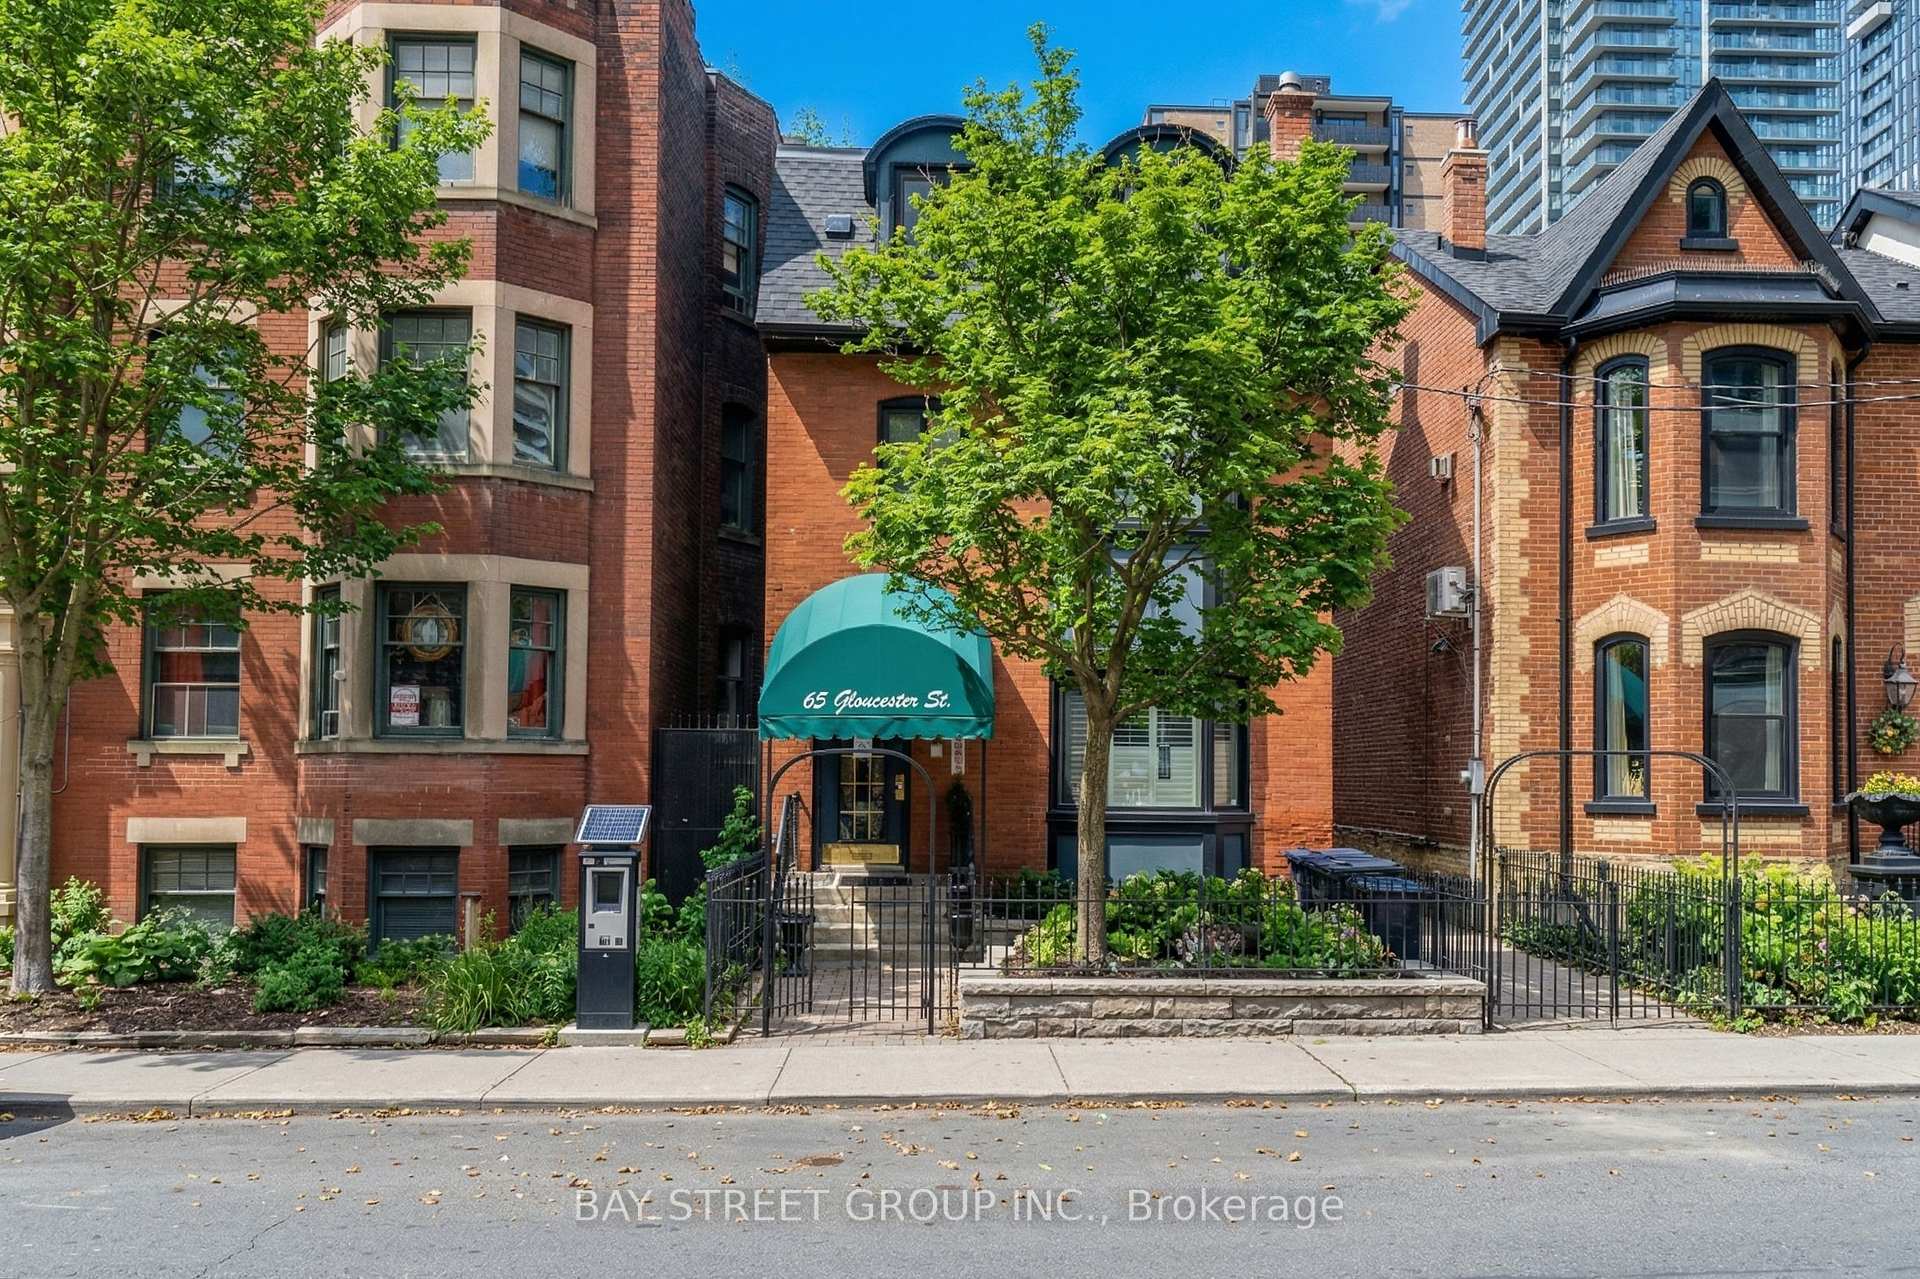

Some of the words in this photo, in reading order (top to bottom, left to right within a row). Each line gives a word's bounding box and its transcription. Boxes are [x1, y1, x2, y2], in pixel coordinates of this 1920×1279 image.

[803, 691, 829, 709] 65
[834, 690, 918, 715] Gloucester
[924, 690, 951, 708] St.
